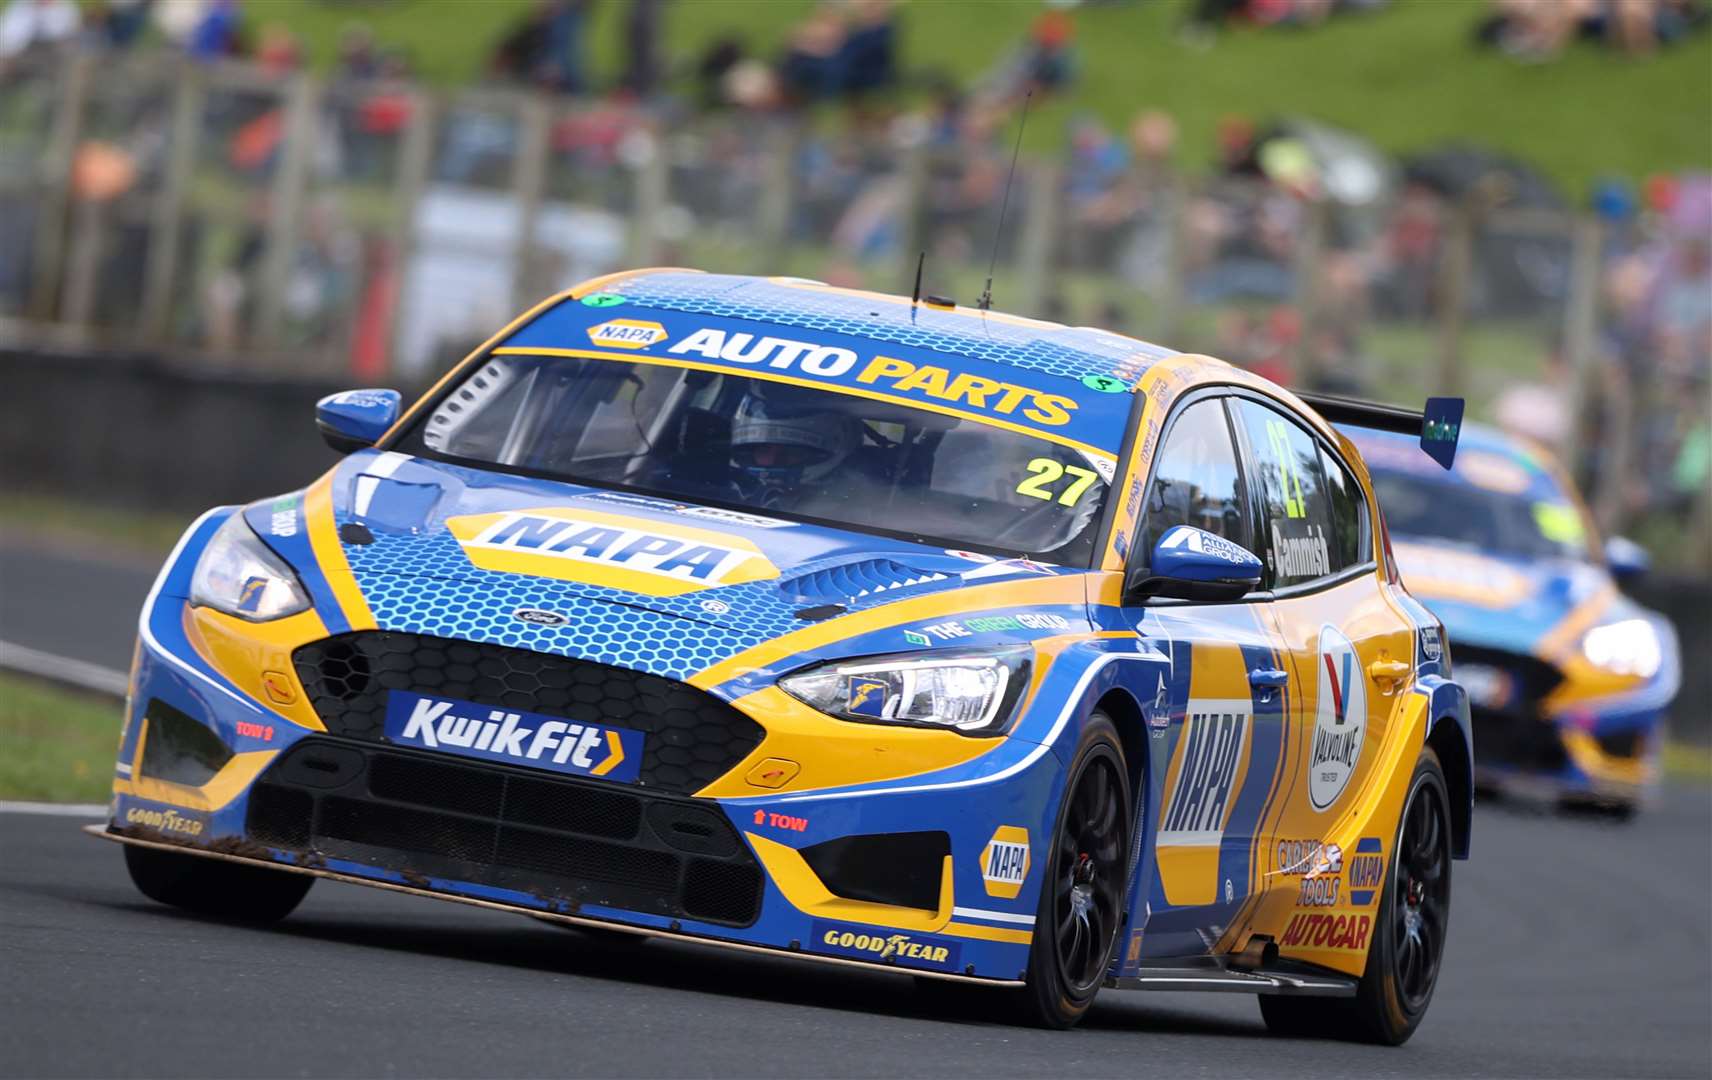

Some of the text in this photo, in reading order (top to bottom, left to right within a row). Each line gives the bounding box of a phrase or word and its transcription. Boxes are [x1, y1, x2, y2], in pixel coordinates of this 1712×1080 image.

[599, 325, 655, 343] NAPA
[667, 328, 858, 377] AUTO
[856, 355, 1080, 426] PARTS
[1015, 458, 1099, 507] 27
[488, 516, 731, 579] NAPA
[1203, 545, 1245, 565] GROUP
[1271, 523, 1331, 577] Cammish
[923, 621, 973, 640] THE
[236, 721, 264, 738] TOW
[1312, 724, 1359, 768] VALVOLINE
[1164, 714, 1245, 831] NAPA
[769, 813, 809, 832] TOW
[987, 844, 1028, 881] NAPA
[1350, 856, 1383, 887] NAPA
[1296, 877, 1341, 907] TOOLS
[1280, 914, 1371, 949] AUTOCAR
